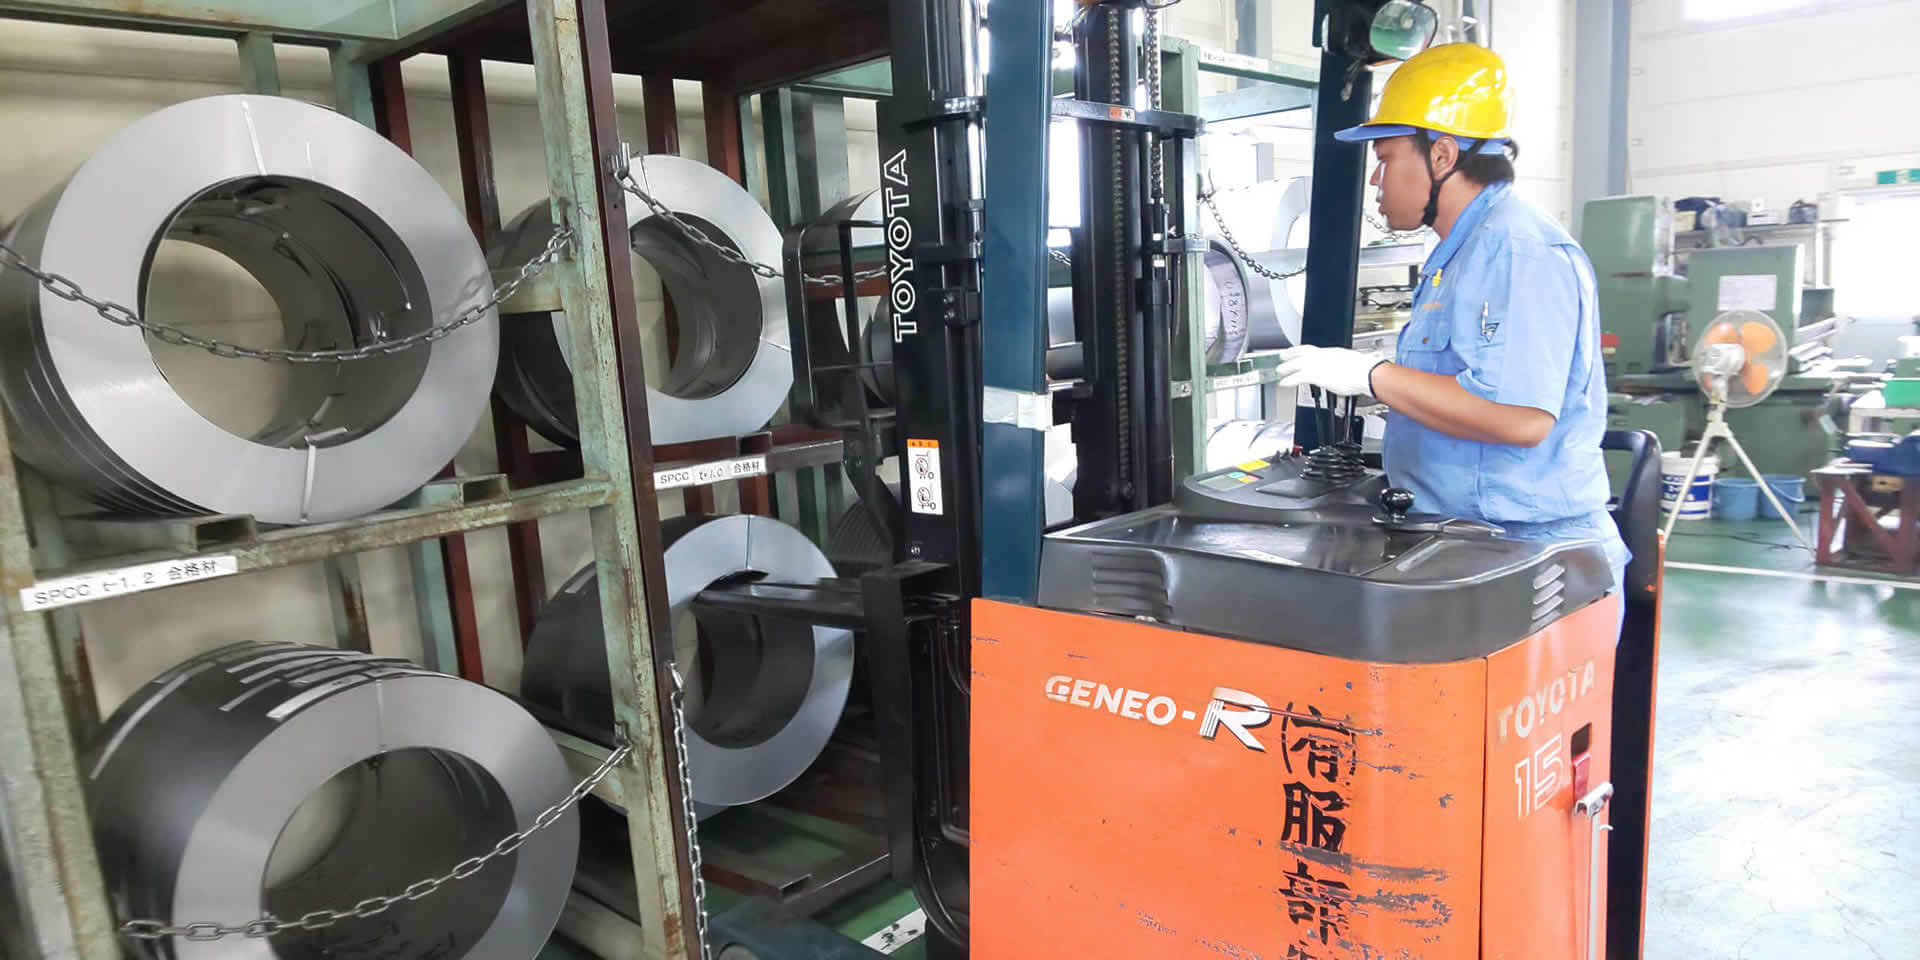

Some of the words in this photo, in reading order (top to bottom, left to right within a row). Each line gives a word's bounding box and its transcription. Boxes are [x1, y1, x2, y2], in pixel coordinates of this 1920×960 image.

[884, 148, 918, 343] TOYOTA
[660, 471, 689, 485] SPCC
[734, 460, 760, 474] 合格材
[34, 583, 90, 605] SPCC
[168, 559, 217, 581] 合格材
[1498, 660, 1595, 741] TOYOTA
[1515, 733, 1563, 819] 15
